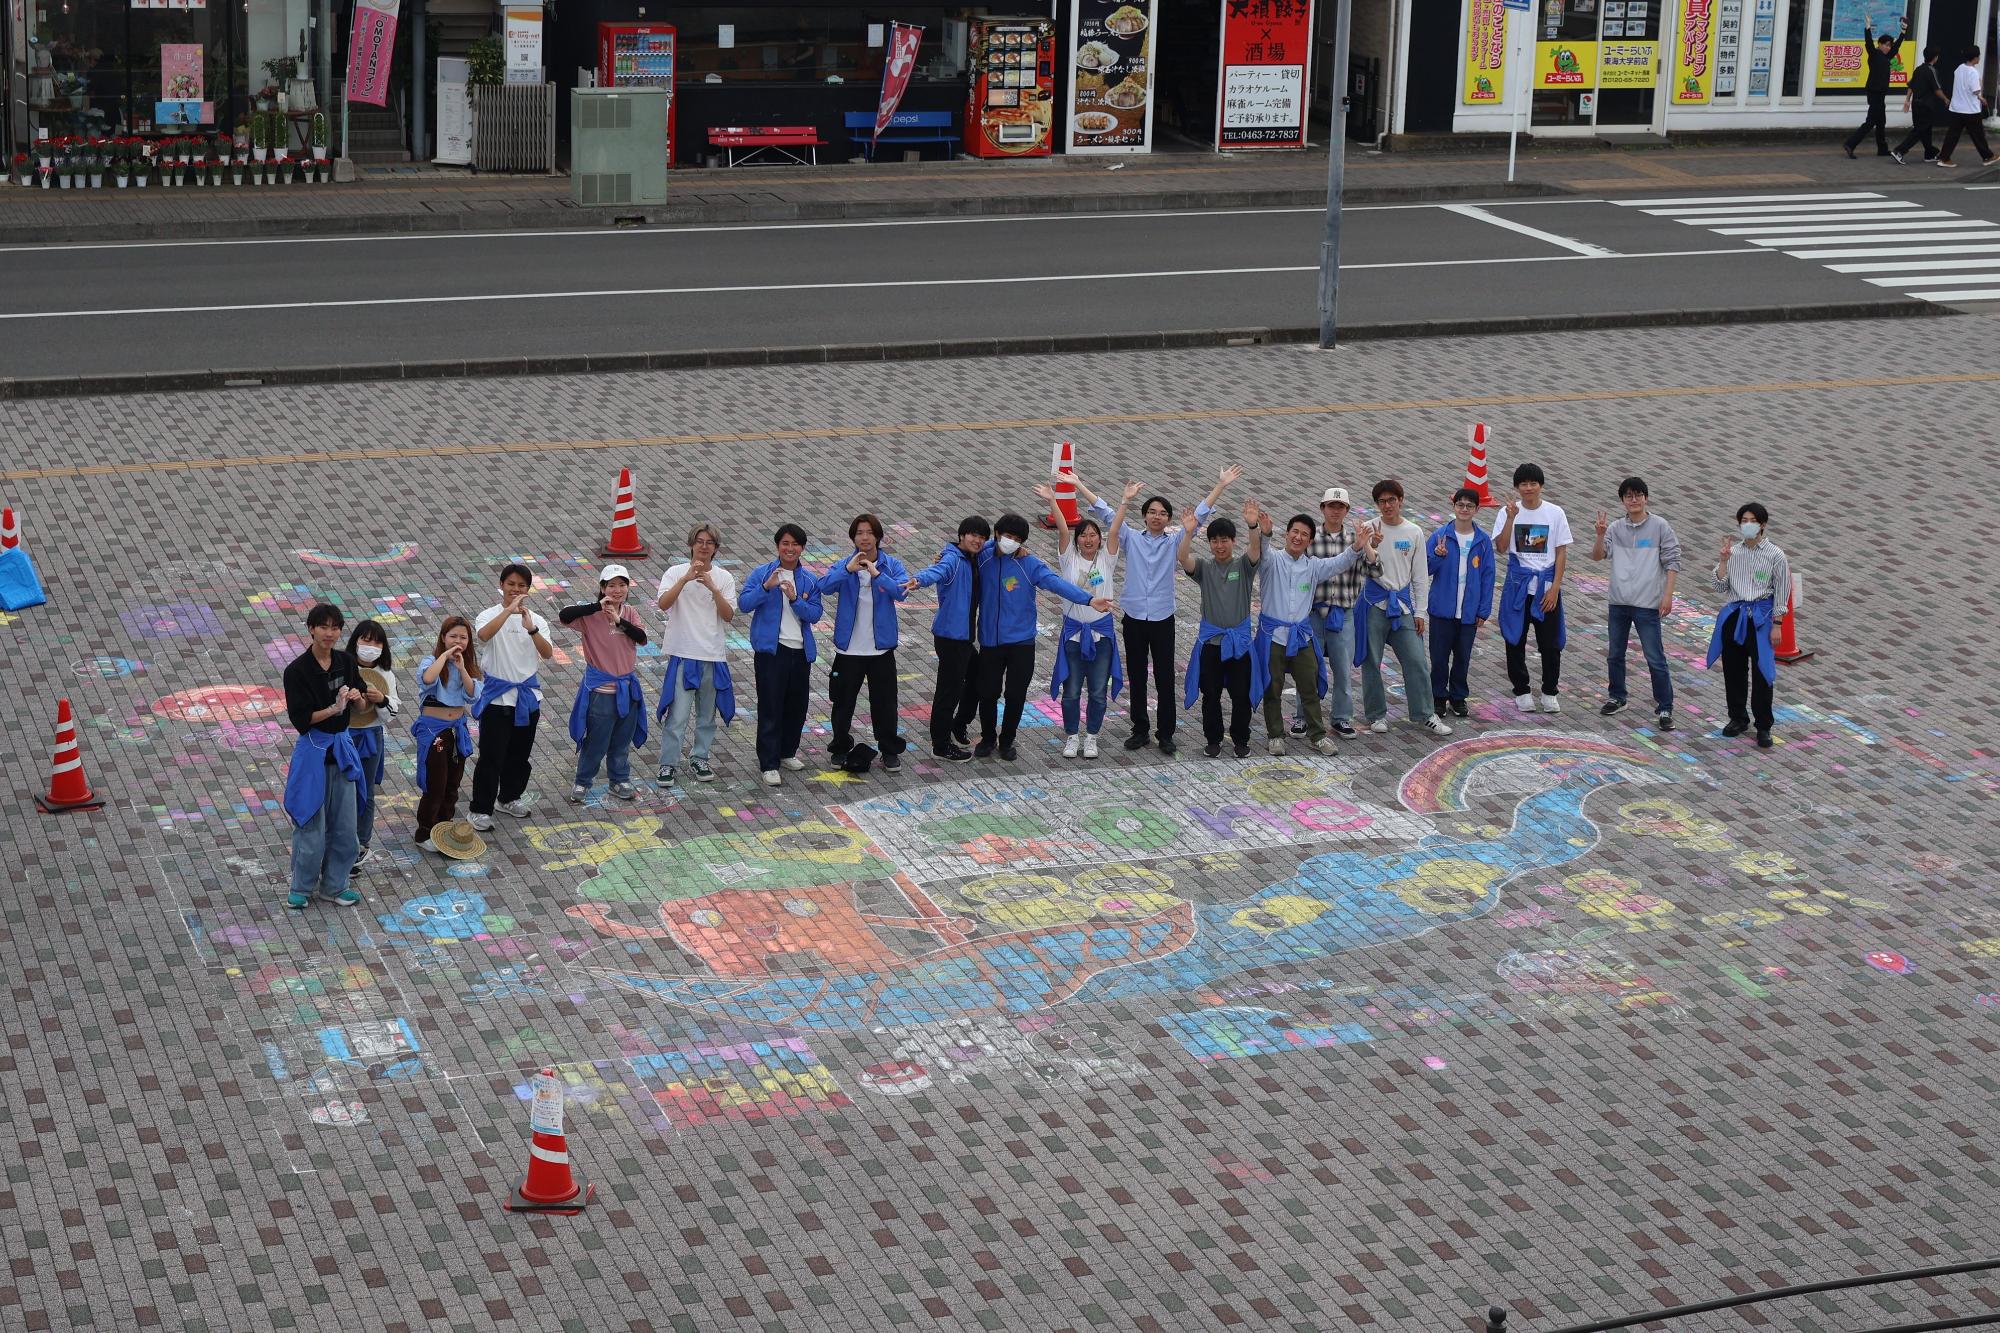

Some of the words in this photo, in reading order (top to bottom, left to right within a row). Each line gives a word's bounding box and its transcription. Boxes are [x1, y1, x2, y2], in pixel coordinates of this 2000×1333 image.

[1722, 20, 1739, 29] 契約
[1490, 0, 1505, 69] のことなら
[1721, 35, 1737, 44] 可能
[1683, 20, 1695, 66] アパート
[1693, 20, 1708, 76] マンション
[1245, 42, 1286, 61] 酒場
[1604, 46, 1653, 55] ユーミーらいふ
[1720, 51, 1736, 59] 物件
[1823, 45, 1863, 57] 不動産の
[1603, 57, 1649, 65] 東海大学前店
[1823, 58, 1862, 69] ことなら
[1229, 69, 1300, 79] パーティー・貸切
[1719, 66, 1735, 74] 多数
[1228, 84, 1288, 94] カラオケルーム
[1227, 98, 1292, 109] 麻雀ルーム完備
[892, 114, 919, 125] pepsi
[1227, 113, 1293, 124] ご予約承ります。
[1223, 130, 1299, 140] TEL:0463-72-7837
